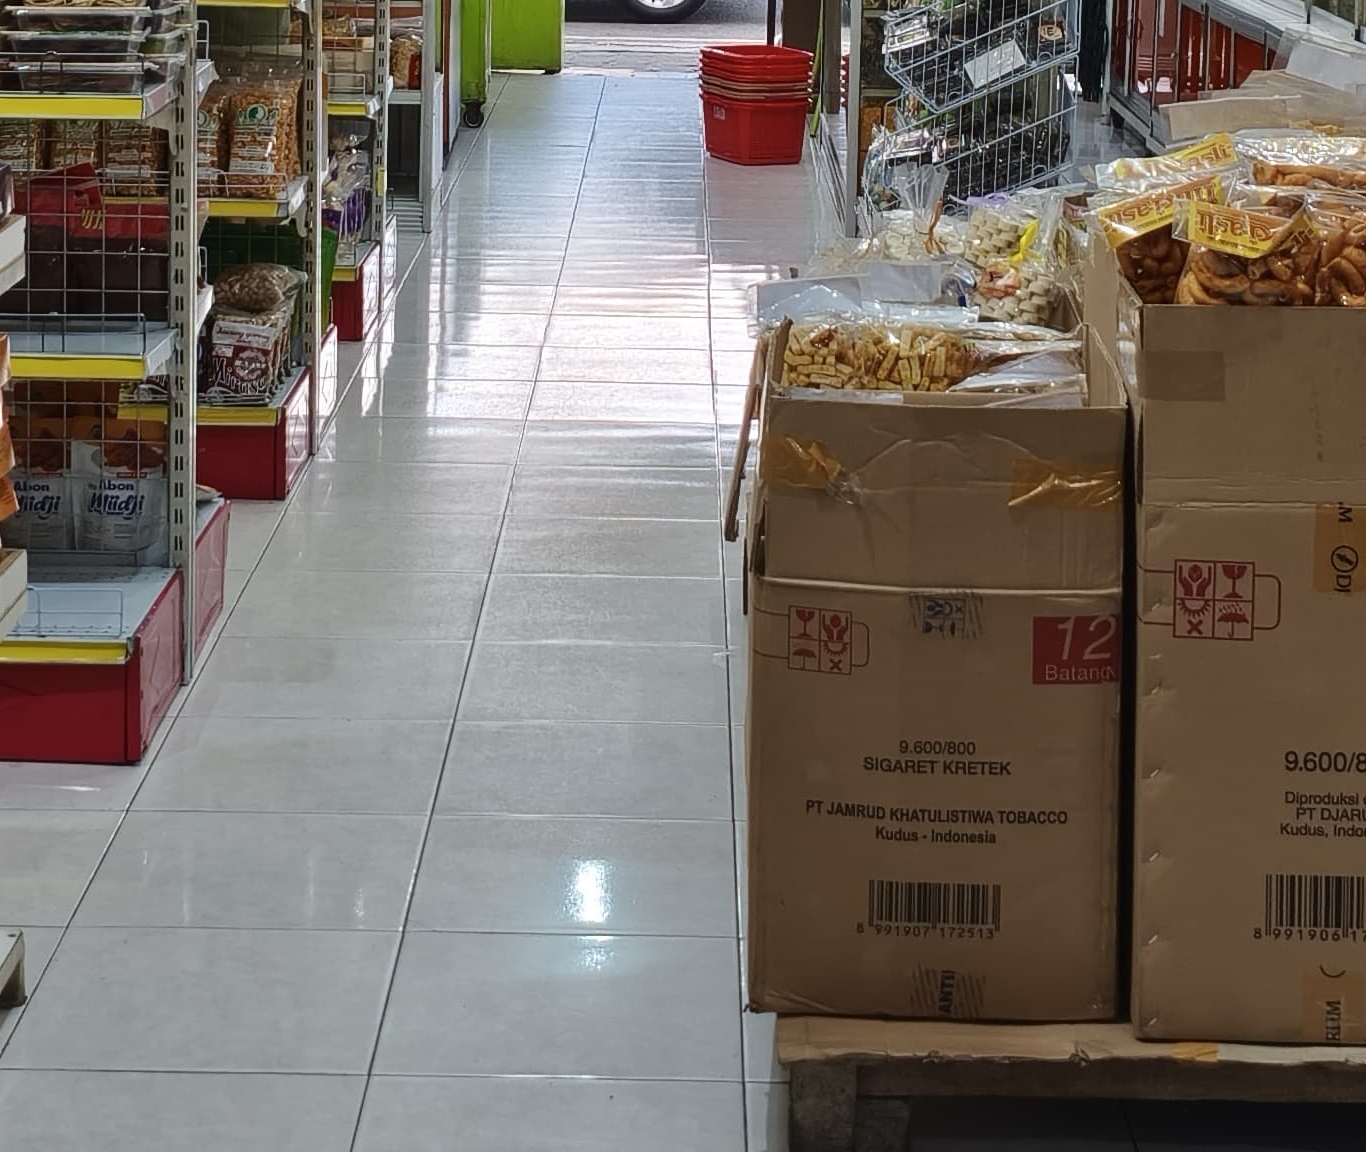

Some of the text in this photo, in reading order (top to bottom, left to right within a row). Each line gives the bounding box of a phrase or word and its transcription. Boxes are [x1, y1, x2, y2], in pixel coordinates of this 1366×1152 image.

[14, 480, 50, 492] Abon
[98, 479, 134, 492] Abon
[1055, 615, 1118, 662] 12
[898, 739, 976, 757] 9.600/800
[863, 756, 1012, 776] SIGARET KRETEK
[1284, 791, 1359, 809] Diproduksi
[805, 800, 1068, 826] PT JAMRUD KHATULISTIWA TOBACCO
[1296, 807, 1318, 822] PT
[875, 826, 919, 842] Kudus
[931, 828, 997, 844] Indonesia
[1279, 823, 1329, 840] Kudus,
